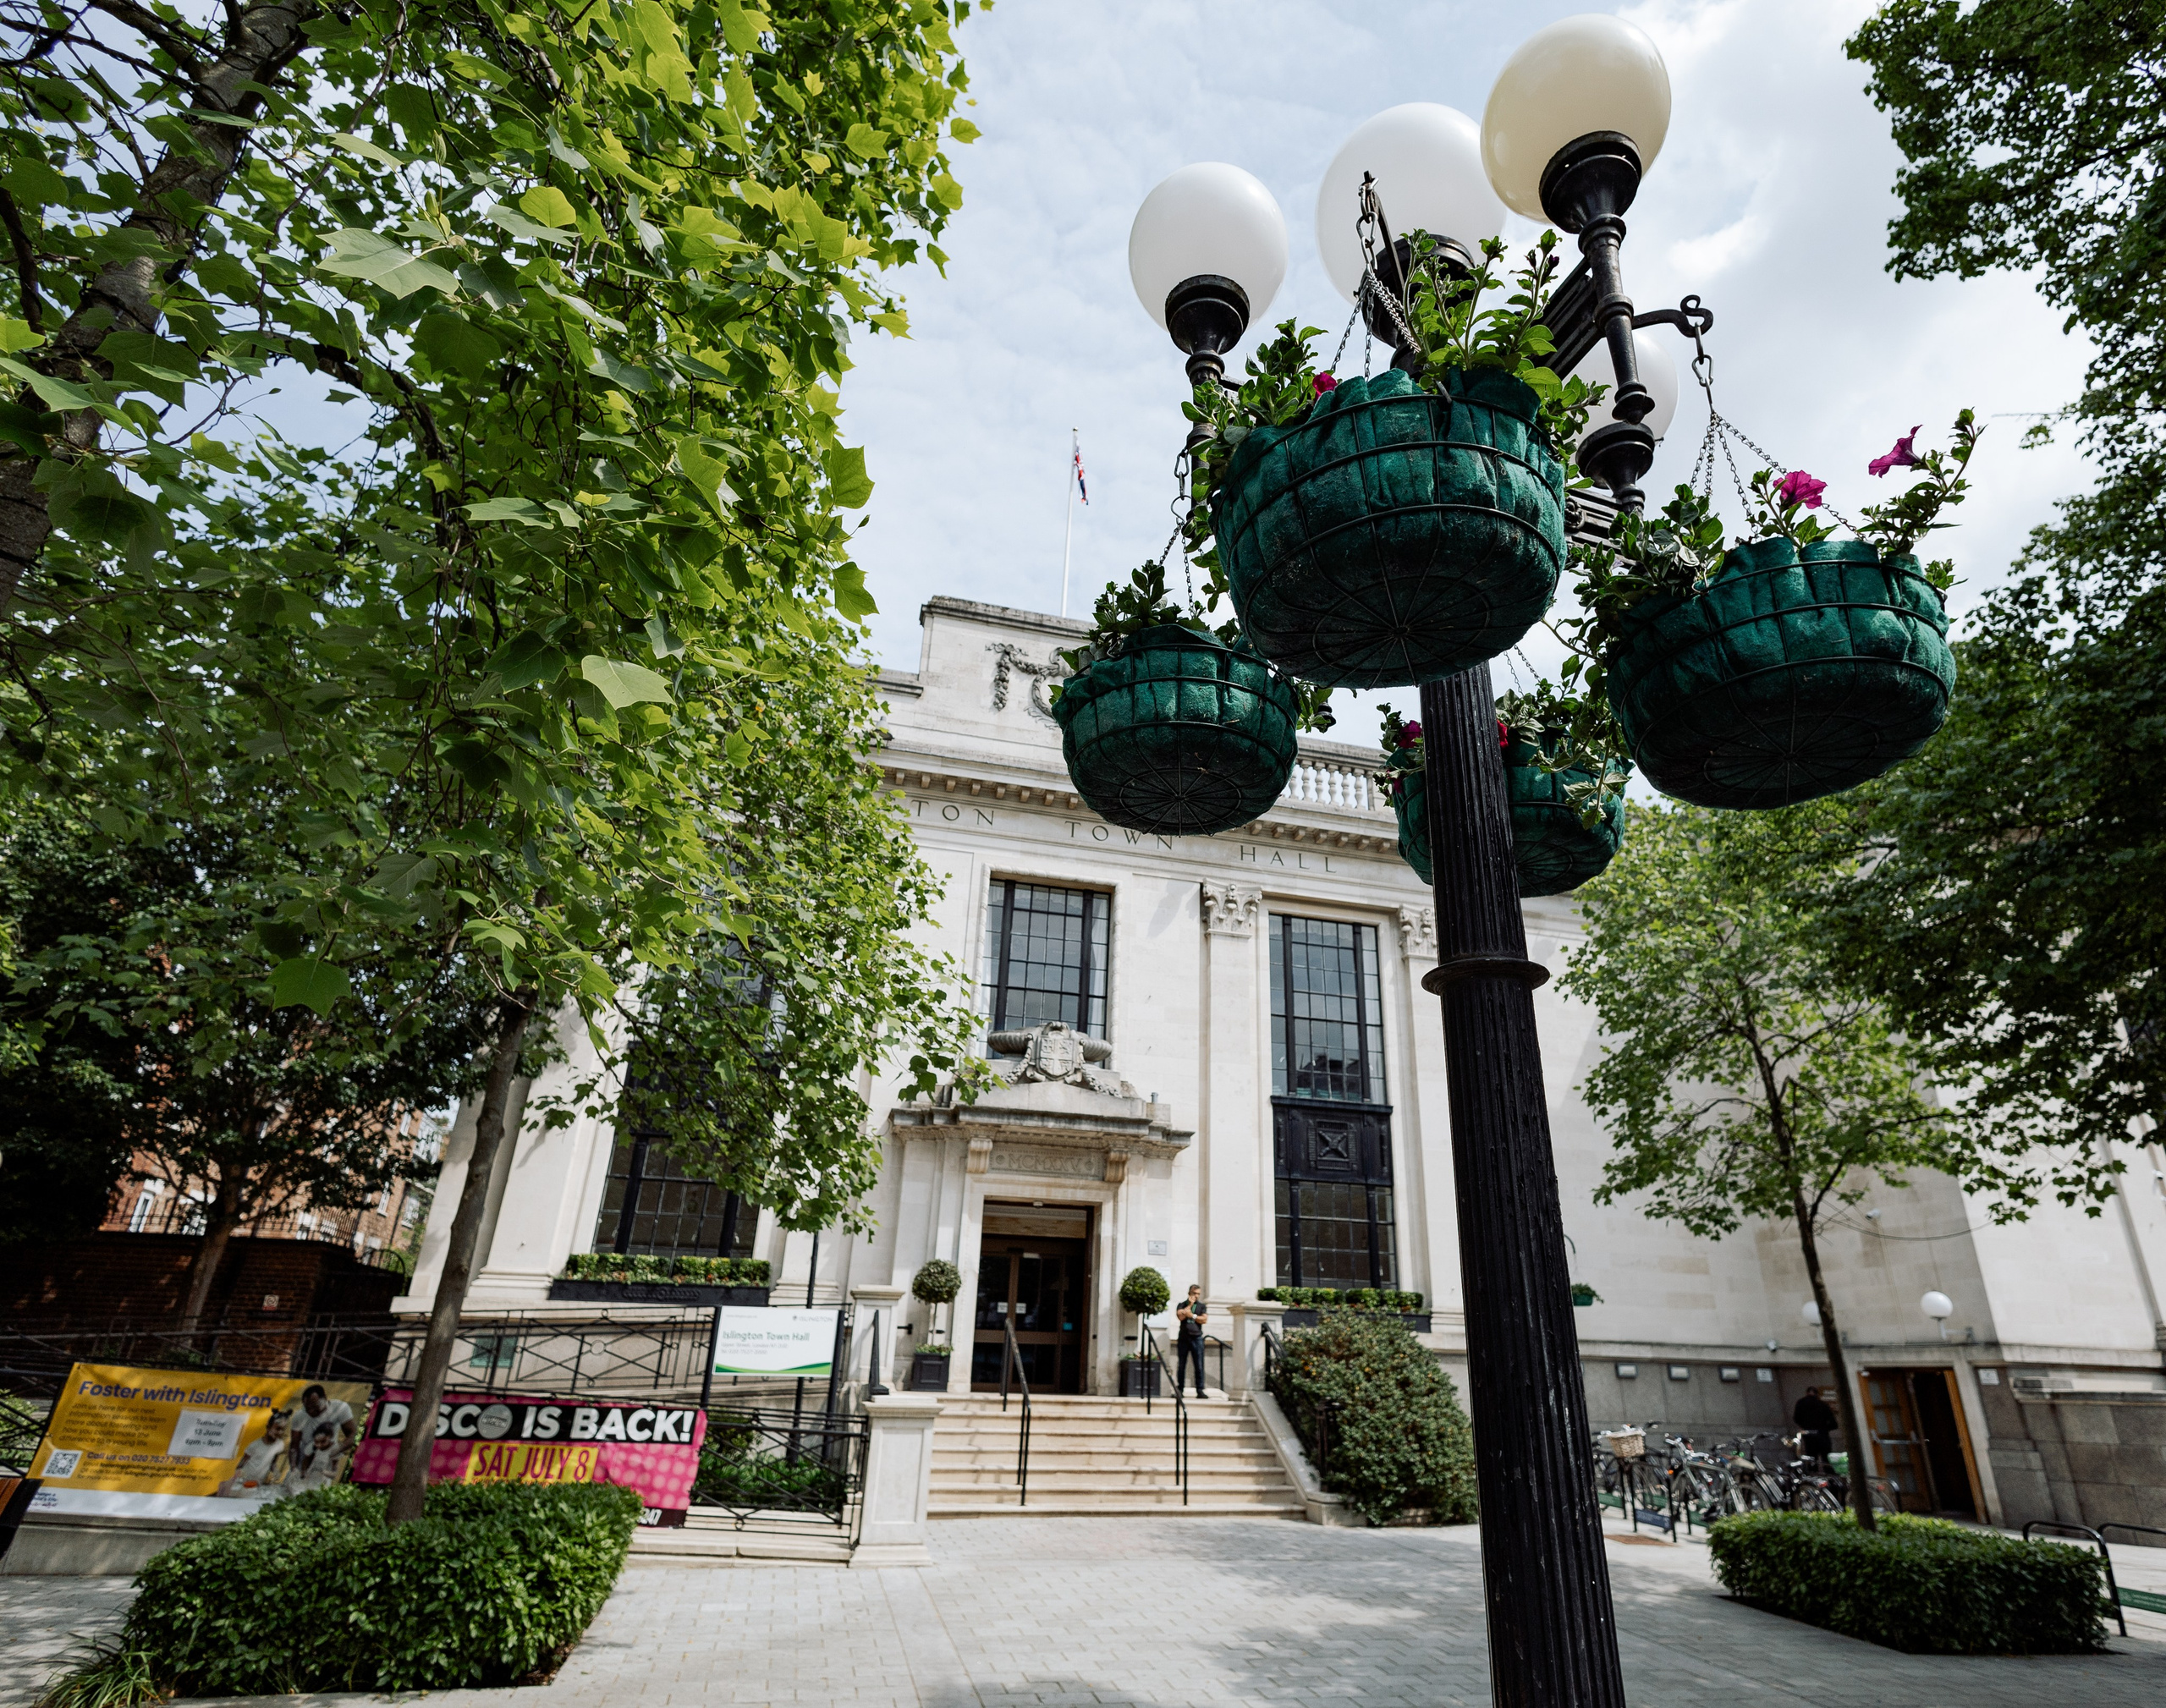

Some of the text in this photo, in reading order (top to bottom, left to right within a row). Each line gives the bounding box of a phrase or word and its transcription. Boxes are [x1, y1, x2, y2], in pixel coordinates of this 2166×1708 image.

[1064, 821, 1174, 850] TOWN
[1240, 845, 1337, 874] HALL
[723, 1330, 811, 1342] Islington Town Hall
[79, 1381, 272, 1411] Foster with Islington
[203, 1428, 222, 1436] June
[377, 1403, 695, 1442] DSCO IS BACK!
[87, 1451, 105, 1460] Call
[131, 1454, 148, 1463] 020
[473, 1444, 590, 1481] SAT JULY 8
